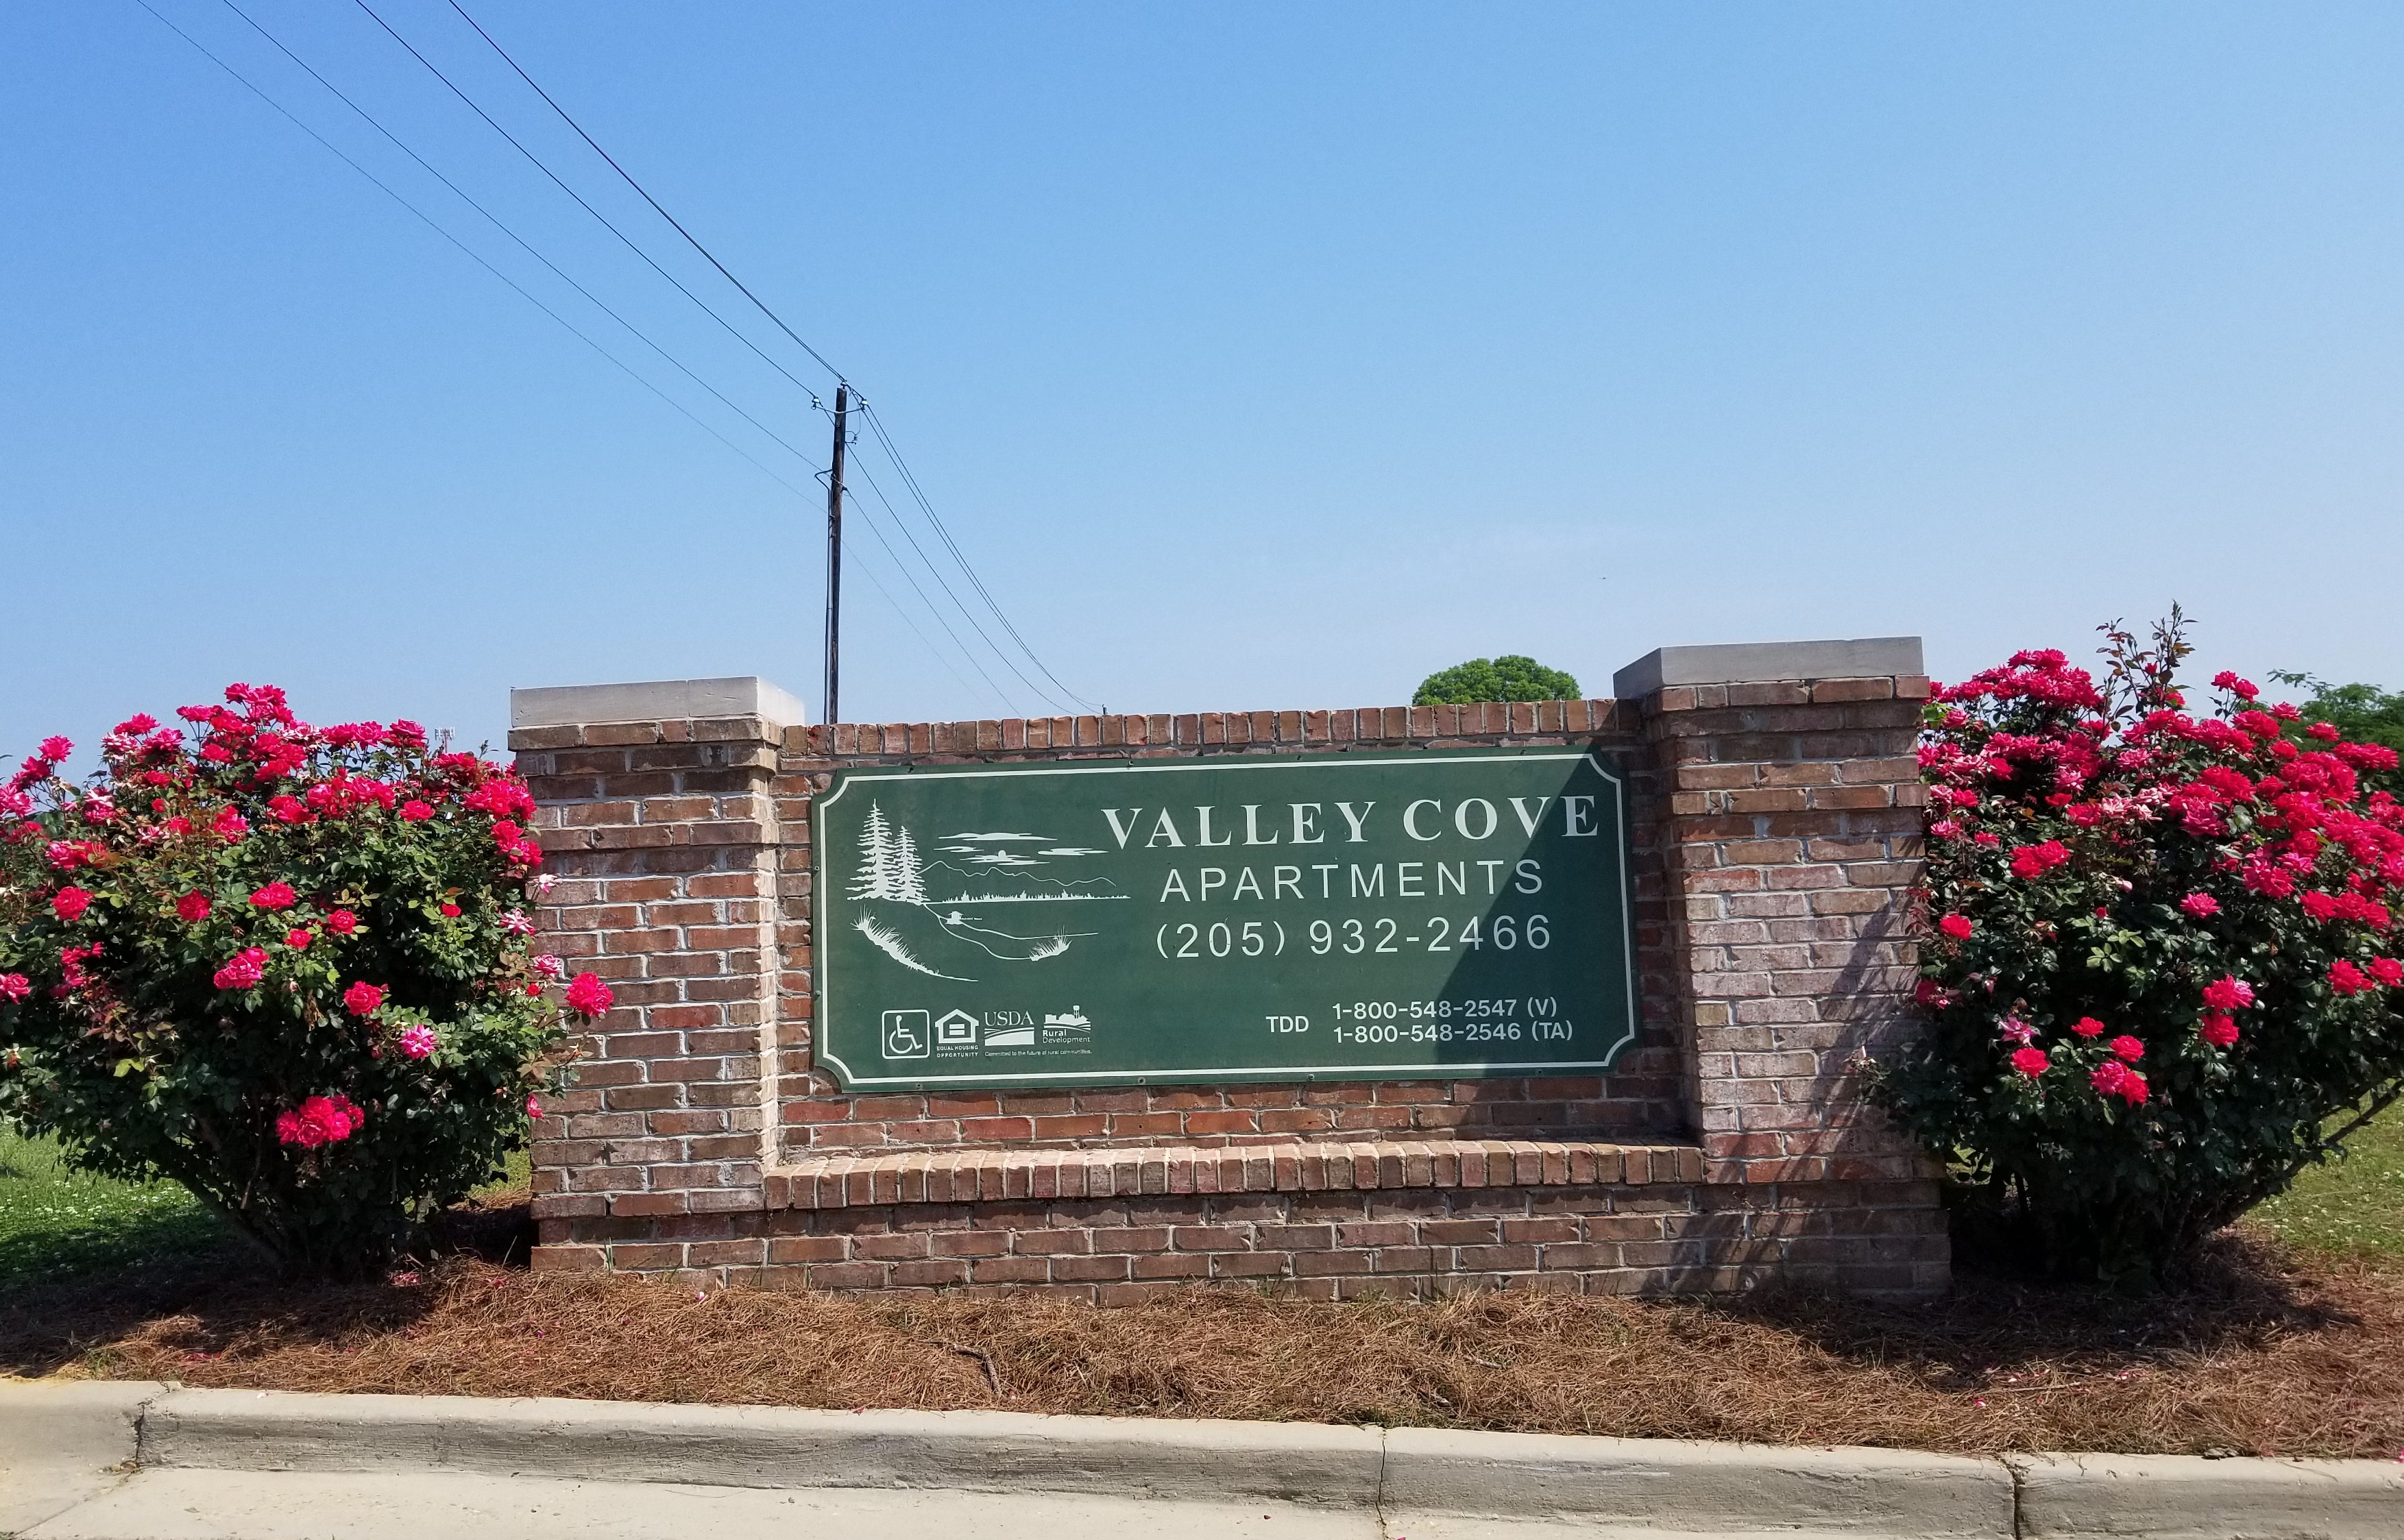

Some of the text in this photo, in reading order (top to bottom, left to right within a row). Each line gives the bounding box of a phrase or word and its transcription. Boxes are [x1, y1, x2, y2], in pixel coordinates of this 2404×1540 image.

[1101, 795, 1599, 850] VALLEY COVE
[1160, 859, 1542, 903] APARTMENTS
[1157, 914, 1551, 959] (205) 932-2466
[984, 1010, 1034, 1026] USDA
[1333, 996, 1557, 1020] 1-800-548-2547 (V)
[1043, 1029, 1067, 1037] Rural
[1265, 1015, 1309, 1033] TDD
[1333, 1020, 1573, 1043] 1-800-548-2546 (TA)
